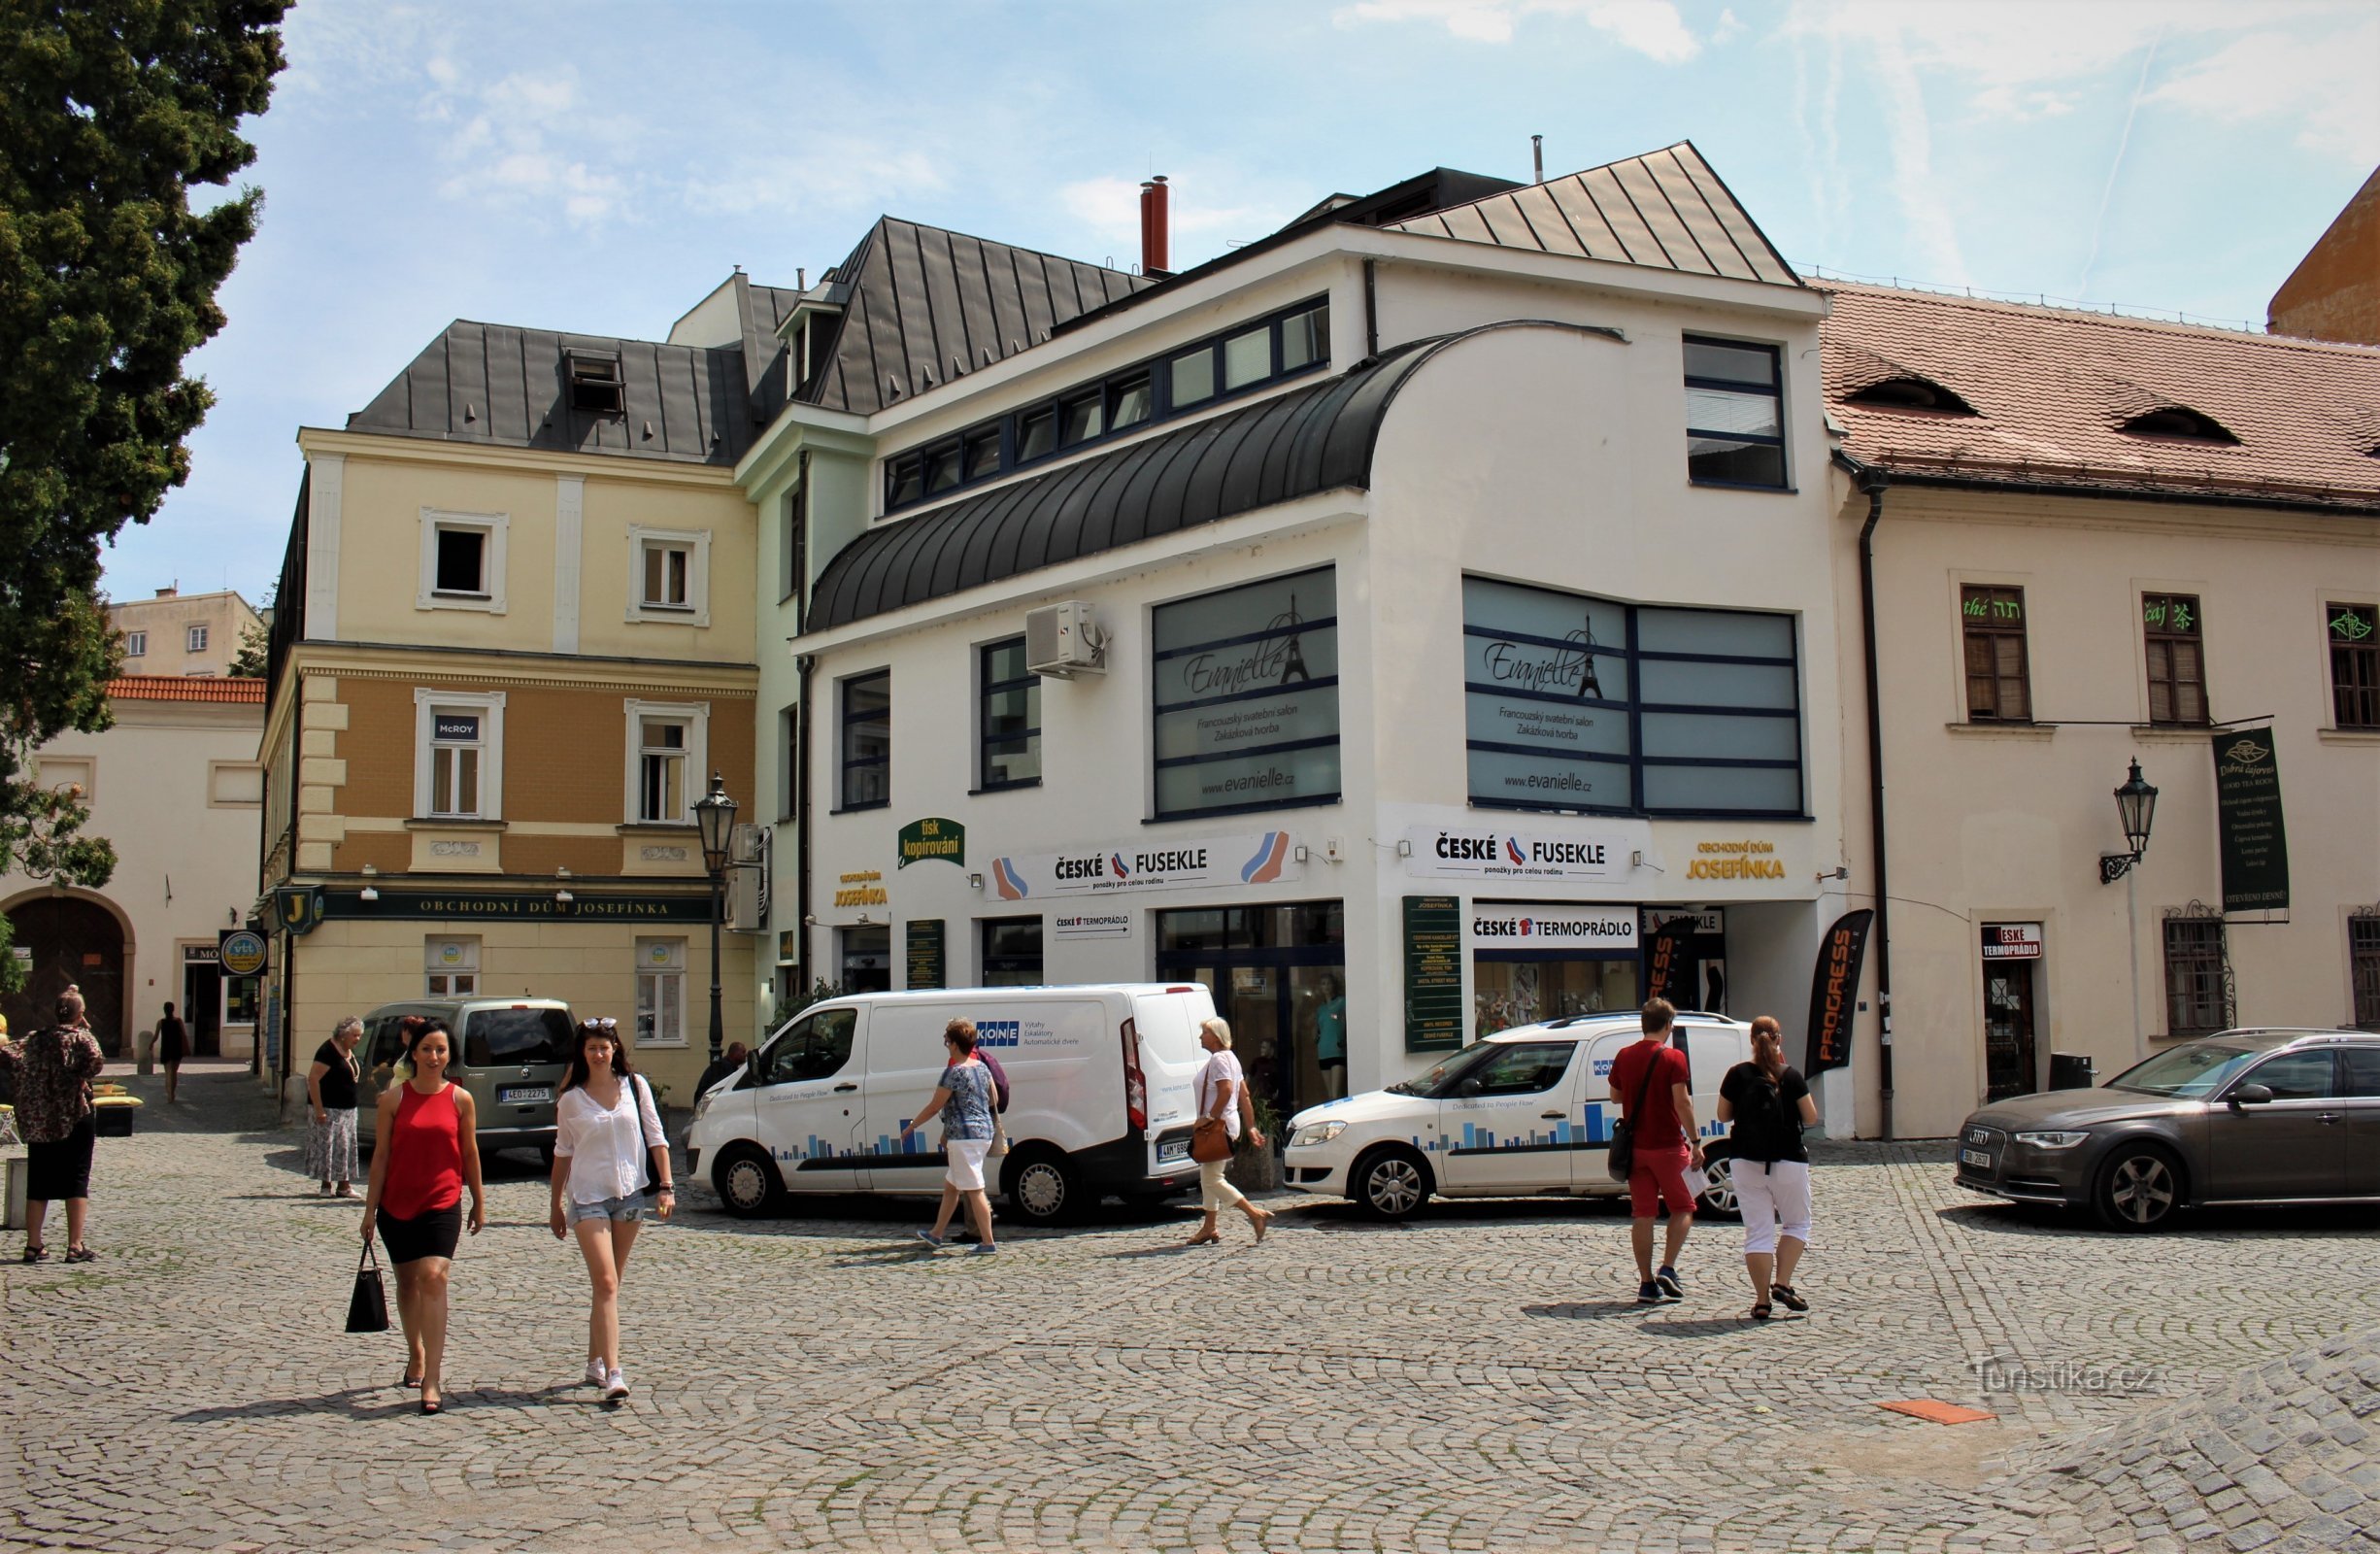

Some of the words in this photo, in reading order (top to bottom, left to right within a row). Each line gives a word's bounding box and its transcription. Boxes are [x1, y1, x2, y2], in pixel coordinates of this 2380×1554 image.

[1962, 597, 1990, 616] thé
[1994, 601, 2020, 619] תה
[2144, 600, 2166, 626] čaj
[2172, 604, 2194, 629] 茶
[1485, 637, 1583, 691] Evanielle
[1196, 713, 1242, 729] Francouzský
[1243, 707, 1276, 723] svatební
[1277, 704, 1297, 717] salon
[1499, 706, 1544, 724] Francouzský
[1545, 711, 1574, 724] svatební
[1575, 717, 1593, 726] salon
[440, 725, 473, 733] McROY
[1215, 726, 1254, 741] Zakázková
[1254, 723, 1279, 736] tvorba
[1517, 724, 1554, 737] Zakázková
[1556, 728, 1578, 740] tvorba
[1201, 767, 1295, 794] www.evanielle.cz
[1505, 772, 1592, 792] www.evanielle.cz
[922, 820, 939, 835] tisk
[904, 835, 958, 859] kopírování
[1436, 831, 1496, 861] ČESKÉ
[1533, 842, 1605, 864] FUSEKLE
[1697, 840, 1750, 853] OBCHODNÍ
[1751, 841, 1773, 853] DŮM
[1056, 853, 1103, 880] ČESKÉ
[1136, 849, 1207, 873] FUSEKLE
[1484, 866, 1511, 875] ponožky
[1686, 855, 1786, 879] JOSEFÍNKA
[1092, 881, 1115, 890] ponožky
[834, 885, 888, 907] JOSEFÍNKA
[287, 895, 305, 922] J
[420, 899, 519, 912] OBCHODNÍ
[529, 900, 567, 913] DŮM
[575, 900, 668, 915] JOSEFÍNKA
[1056, 917, 1075, 927] ČESKÉ
[1083, 915, 1128, 926] TERMOPRÁDLO
[1473, 917, 1517, 936] ČESKÉ
[1535, 918, 1631, 936] TERMOPRÁDLO
[1668, 916, 1715, 929] FKLE
[1998, 928, 2025, 941] ESKÉ
[199, 949, 218, 959] MÓ
[1984, 944, 2038, 957] TERMOPRÁDLO
[1649, 936, 1673, 998] RESS
[1820, 929, 1851, 1061] PROGRESS
[977, 1029, 1018, 1039] KONE
[1593, 1063, 1613, 1073] KO
[527, 1089, 547, 1098] 2275
[769, 1093, 793, 1102] Dedicated
[1453, 1101, 1486, 1111] Dedicated
[1495, 1100, 1518, 1110] People
